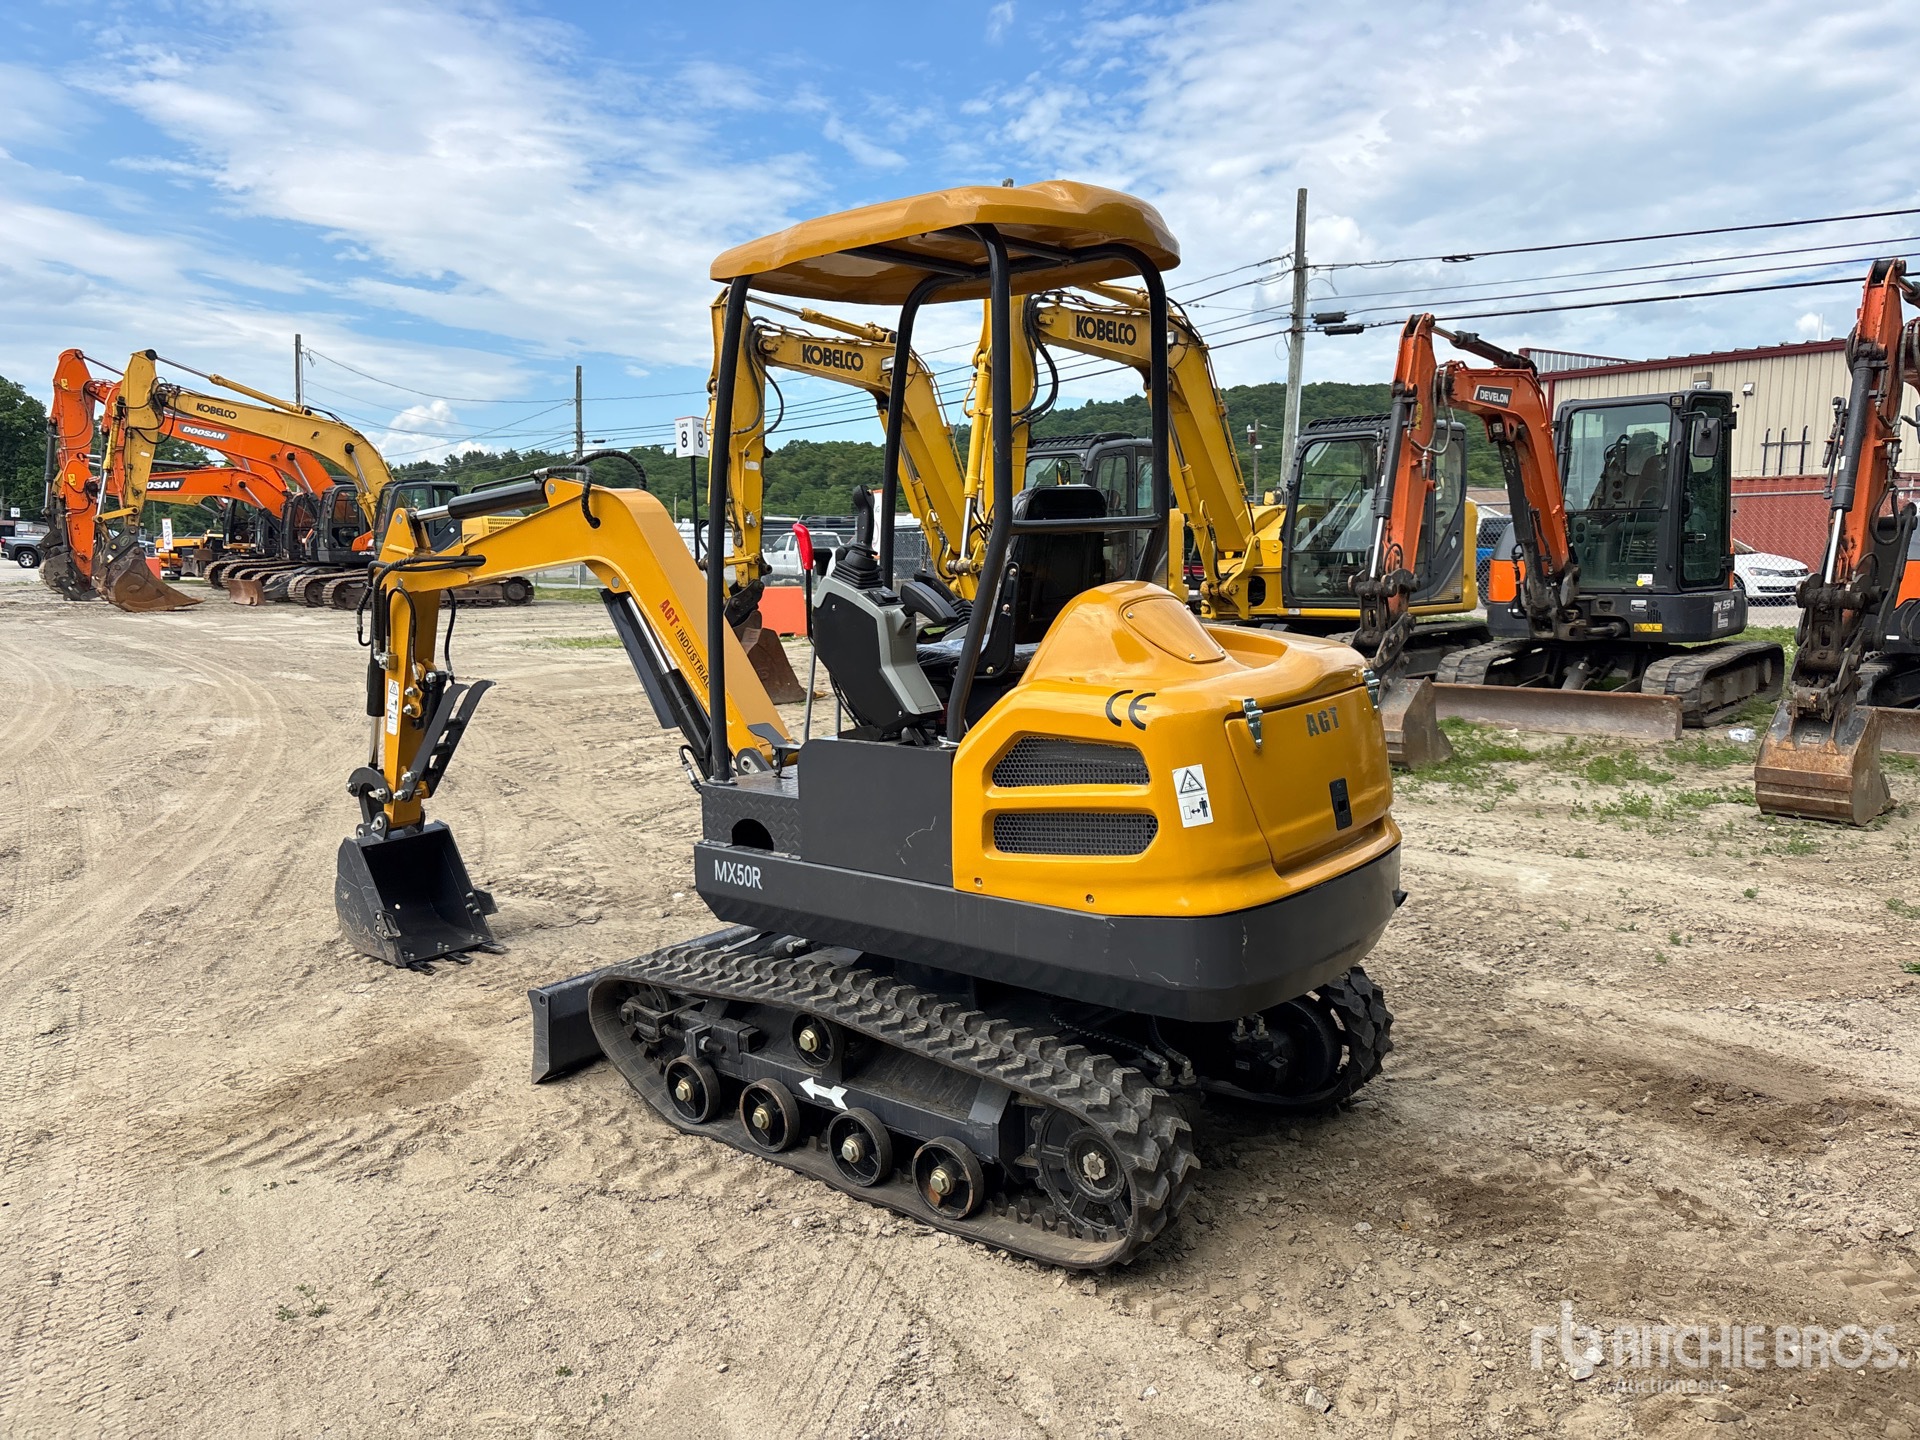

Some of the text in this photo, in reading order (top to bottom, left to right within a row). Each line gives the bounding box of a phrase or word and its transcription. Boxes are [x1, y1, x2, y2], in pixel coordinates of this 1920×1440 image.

[1076, 315, 1136, 346] KOBELCO
[803, 344, 863, 371] KOBELCO
[1479, 390, 1509, 404] DEVELON
[196, 403, 237, 419] KOBELCO
[182, 426, 226, 440] DOOSAN
[681, 431, 688, 448] 8
[698, 431, 704, 448] 8
[146, 481, 180, 489] OSAN
[660, 599, 680, 627] AGT
[1105, 690, 1156, 731] CE
[1306, 707, 1340, 736] AGT
[714, 859, 763, 890] MX50R
